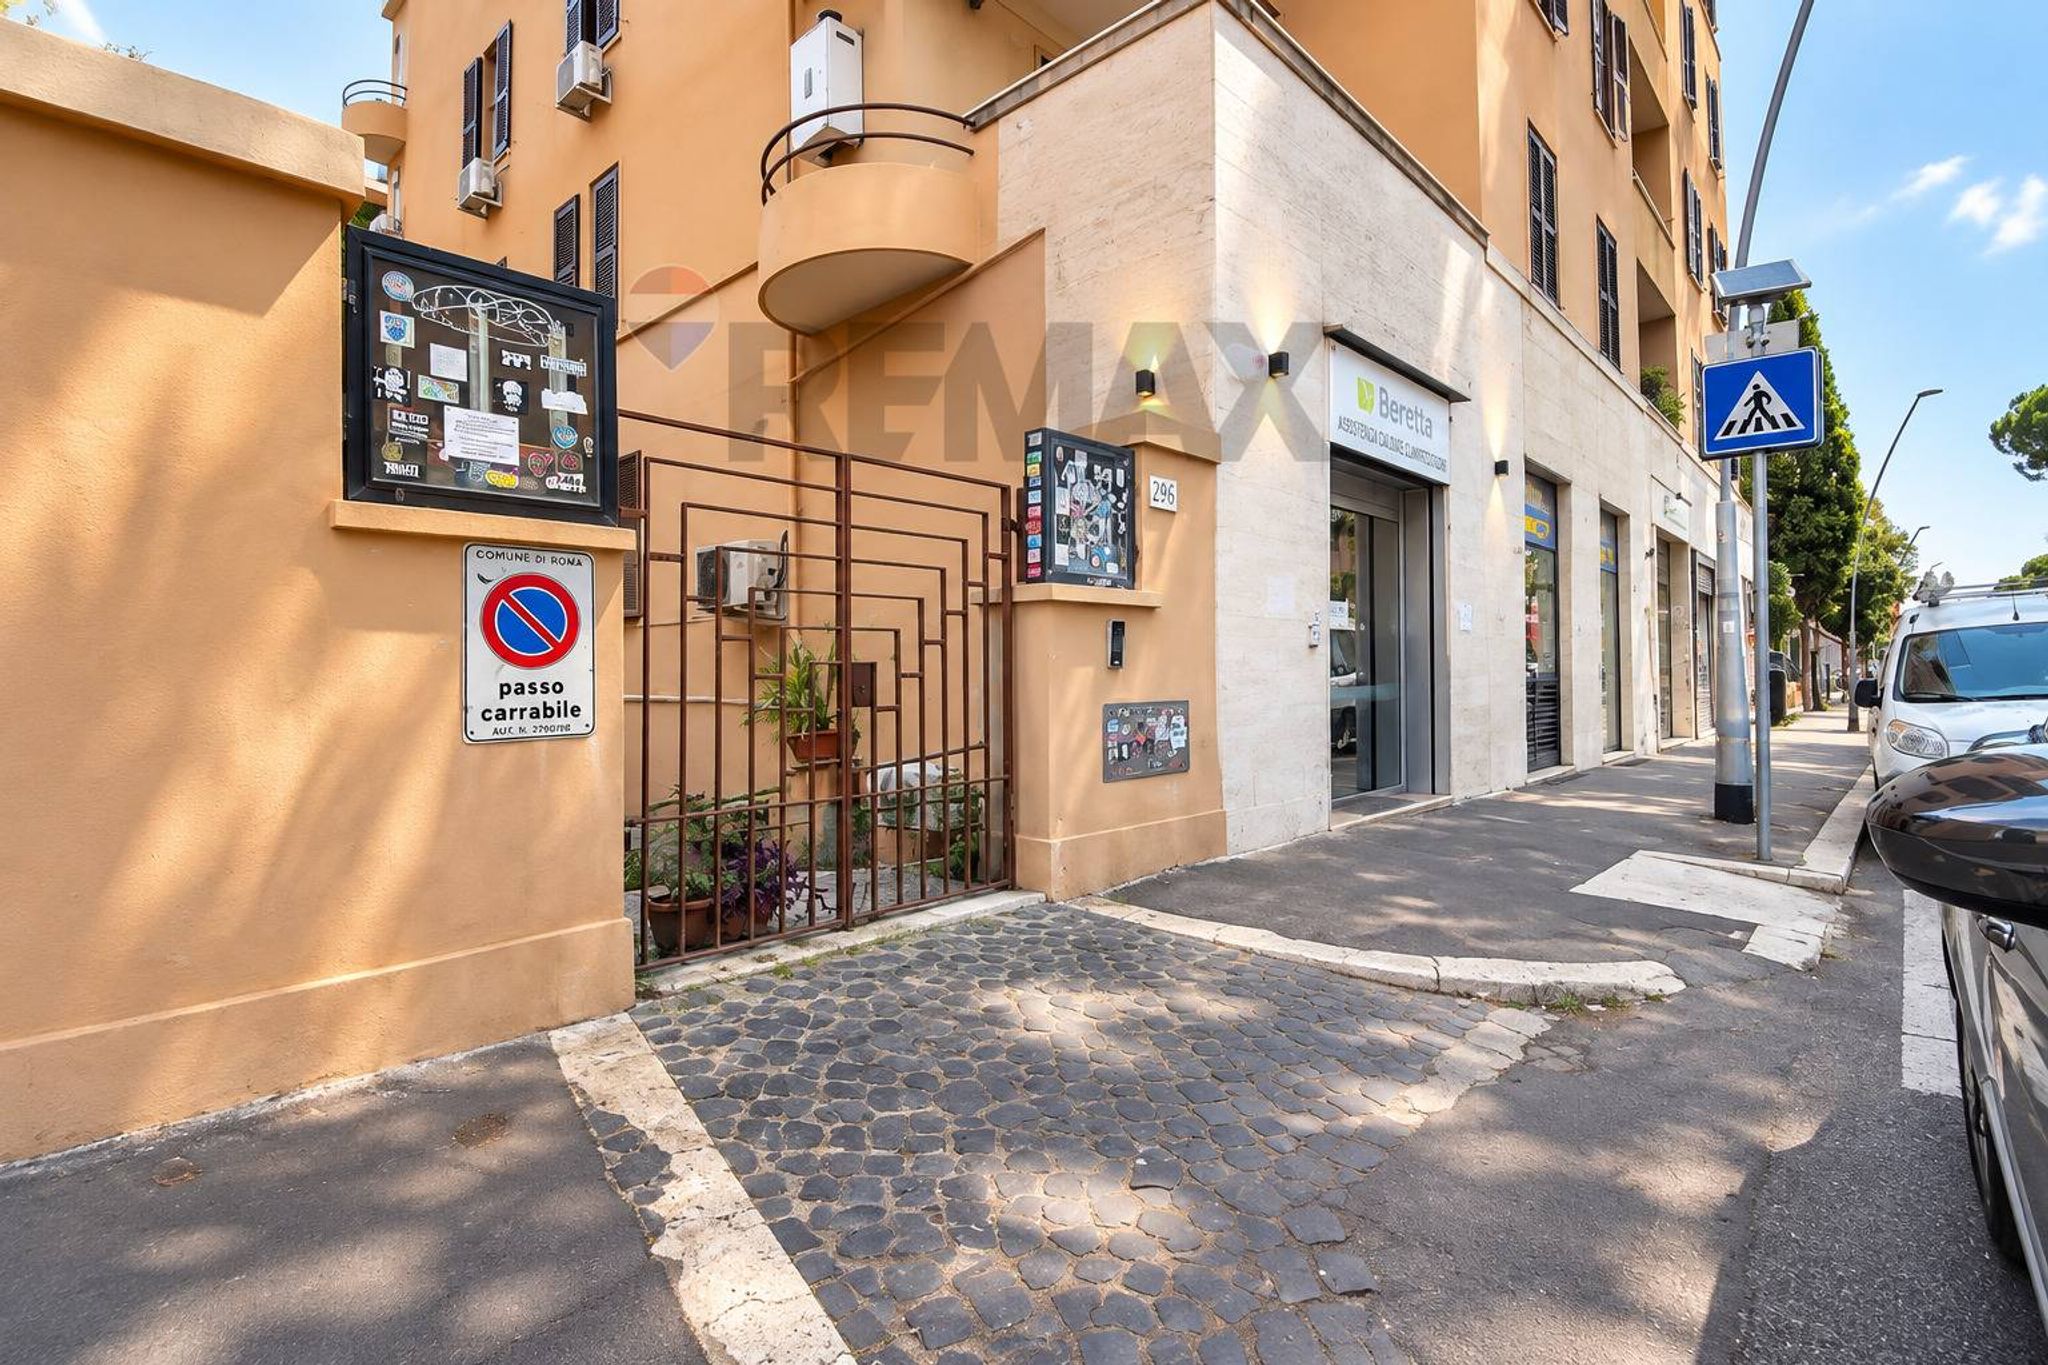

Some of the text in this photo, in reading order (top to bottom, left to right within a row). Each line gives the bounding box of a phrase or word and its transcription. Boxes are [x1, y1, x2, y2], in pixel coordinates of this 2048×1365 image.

[1379, 386, 1432, 439] Beretta
[1152, 480, 1175, 505] 296
[476, 549, 582, 566] COMUNE DI ROMA
[499, 681, 564, 700] passo
[481, 700, 581, 722] carrabile
